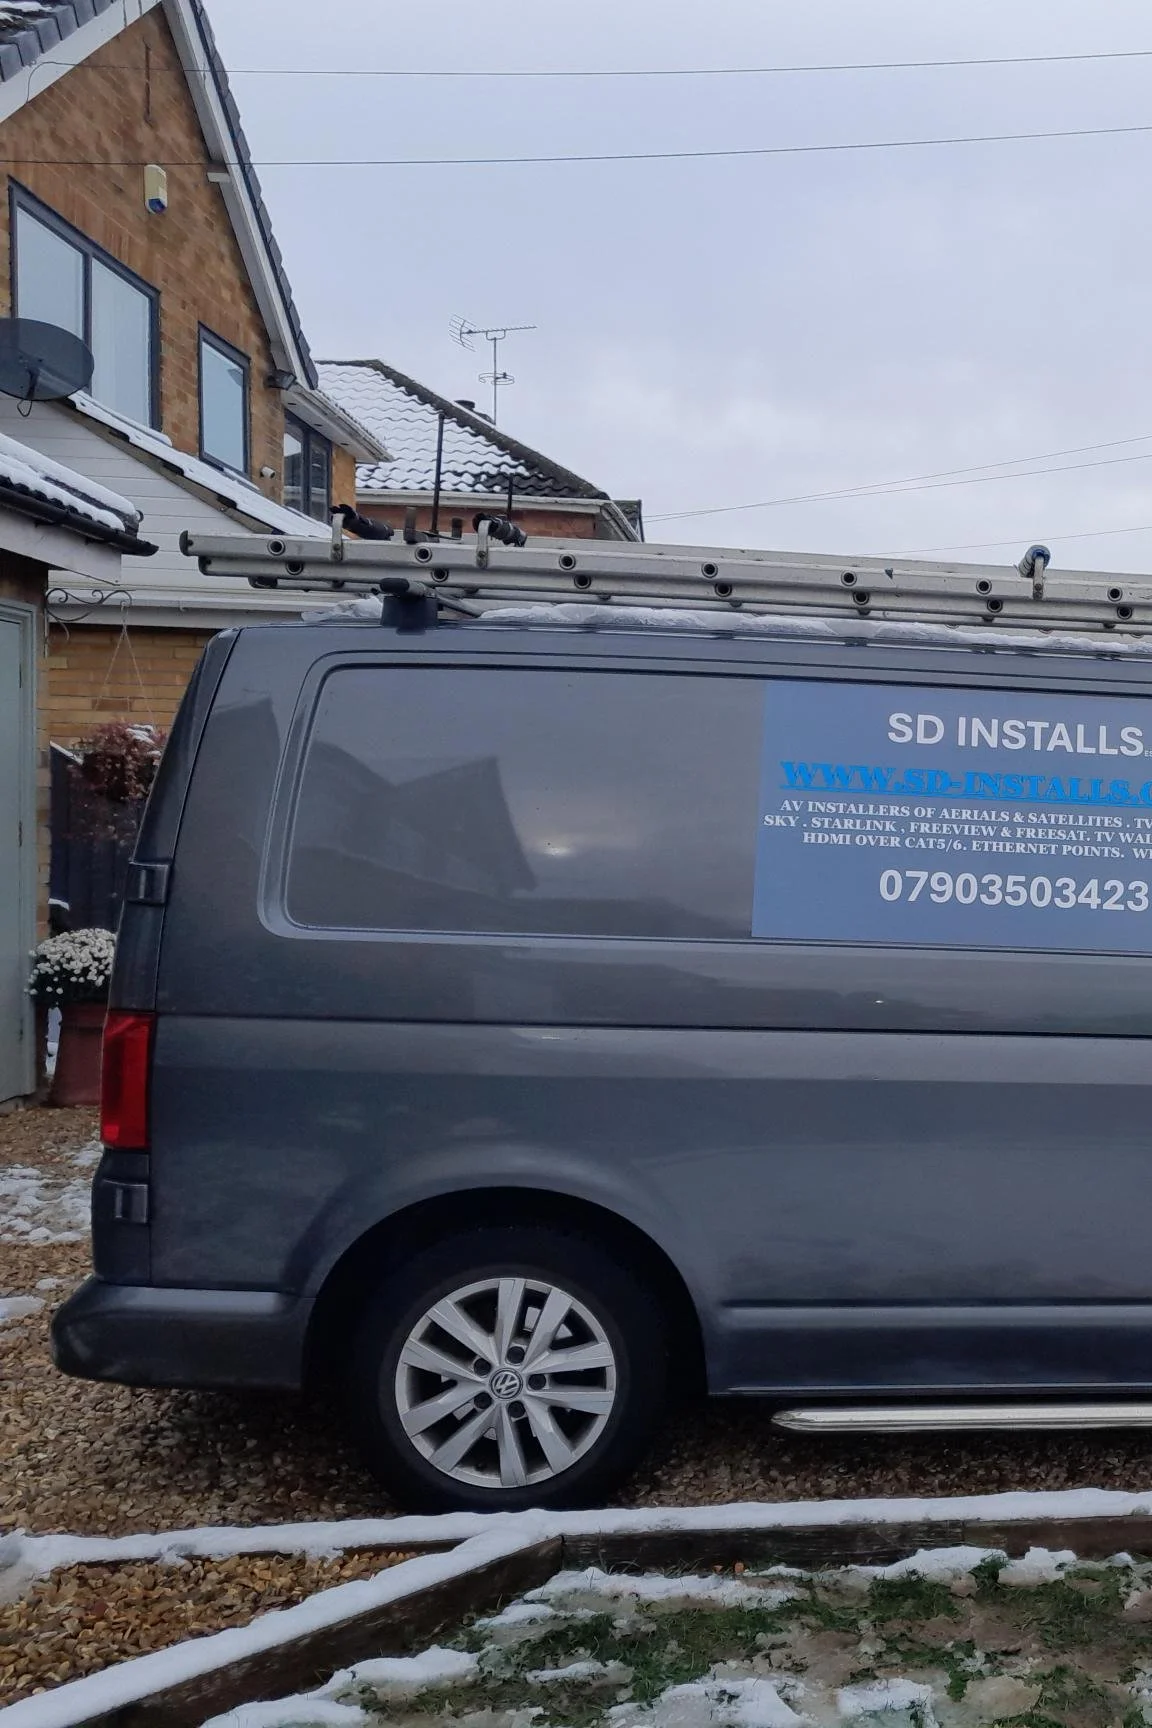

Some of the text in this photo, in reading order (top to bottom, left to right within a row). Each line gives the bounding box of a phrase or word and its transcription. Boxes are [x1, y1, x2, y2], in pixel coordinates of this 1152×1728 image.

[888, 712, 1144, 757] SD INSTALLS
[763, 814, 800, 827] SKY
[811, 816, 897, 832] STARLINK
[909, 822, 997, 837] FREEVIEW
[1000, 826, 1012, 838] &
[1016, 827, 1091, 842] FREESAT.
[1094, 831, 1115, 842] TV
[780, 799, 803, 812] AV
[808, 801, 910, 817] INSTALLERS
[914, 806, 936, 819] OF
[939, 807, 1010, 823] AERIALS
[1013, 811, 1025, 823] &
[1027, 812, 1123, 828] SATELLITES
[802, 832, 851, 845] HDMI
[855, 834, 901, 848] OVER
[904, 837, 967, 852] CAT5/6.
[971, 840, 1058, 855] ETHERNET
[1062, 844, 1125, 859] POINTS.
[879, 869, 1150, 912] 07903503423
